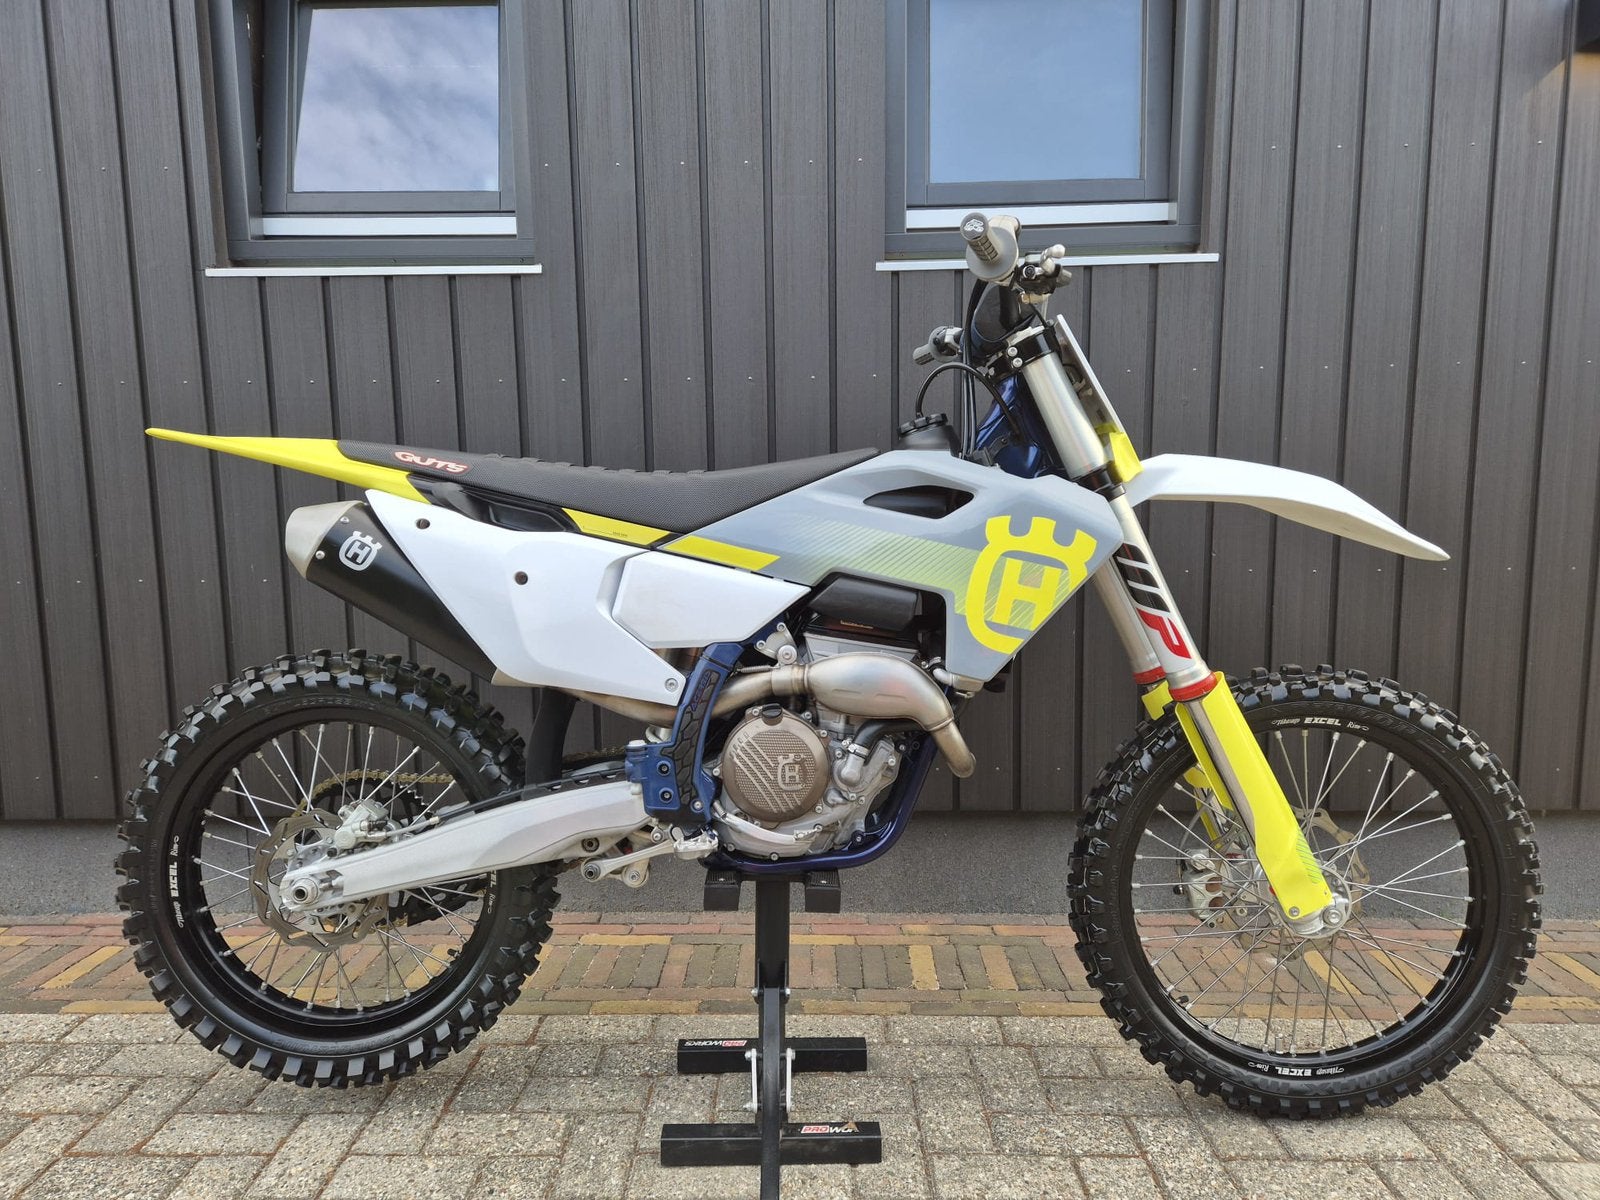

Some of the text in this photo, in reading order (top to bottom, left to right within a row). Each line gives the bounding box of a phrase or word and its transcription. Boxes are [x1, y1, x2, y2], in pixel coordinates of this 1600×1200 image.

[394, 451, 468, 473] GUTS
[1303, 716, 1342, 726] EXCEL
[169, 861, 179, 897] EXCEL
[1274, 1066, 1313, 1077] EXCEL
